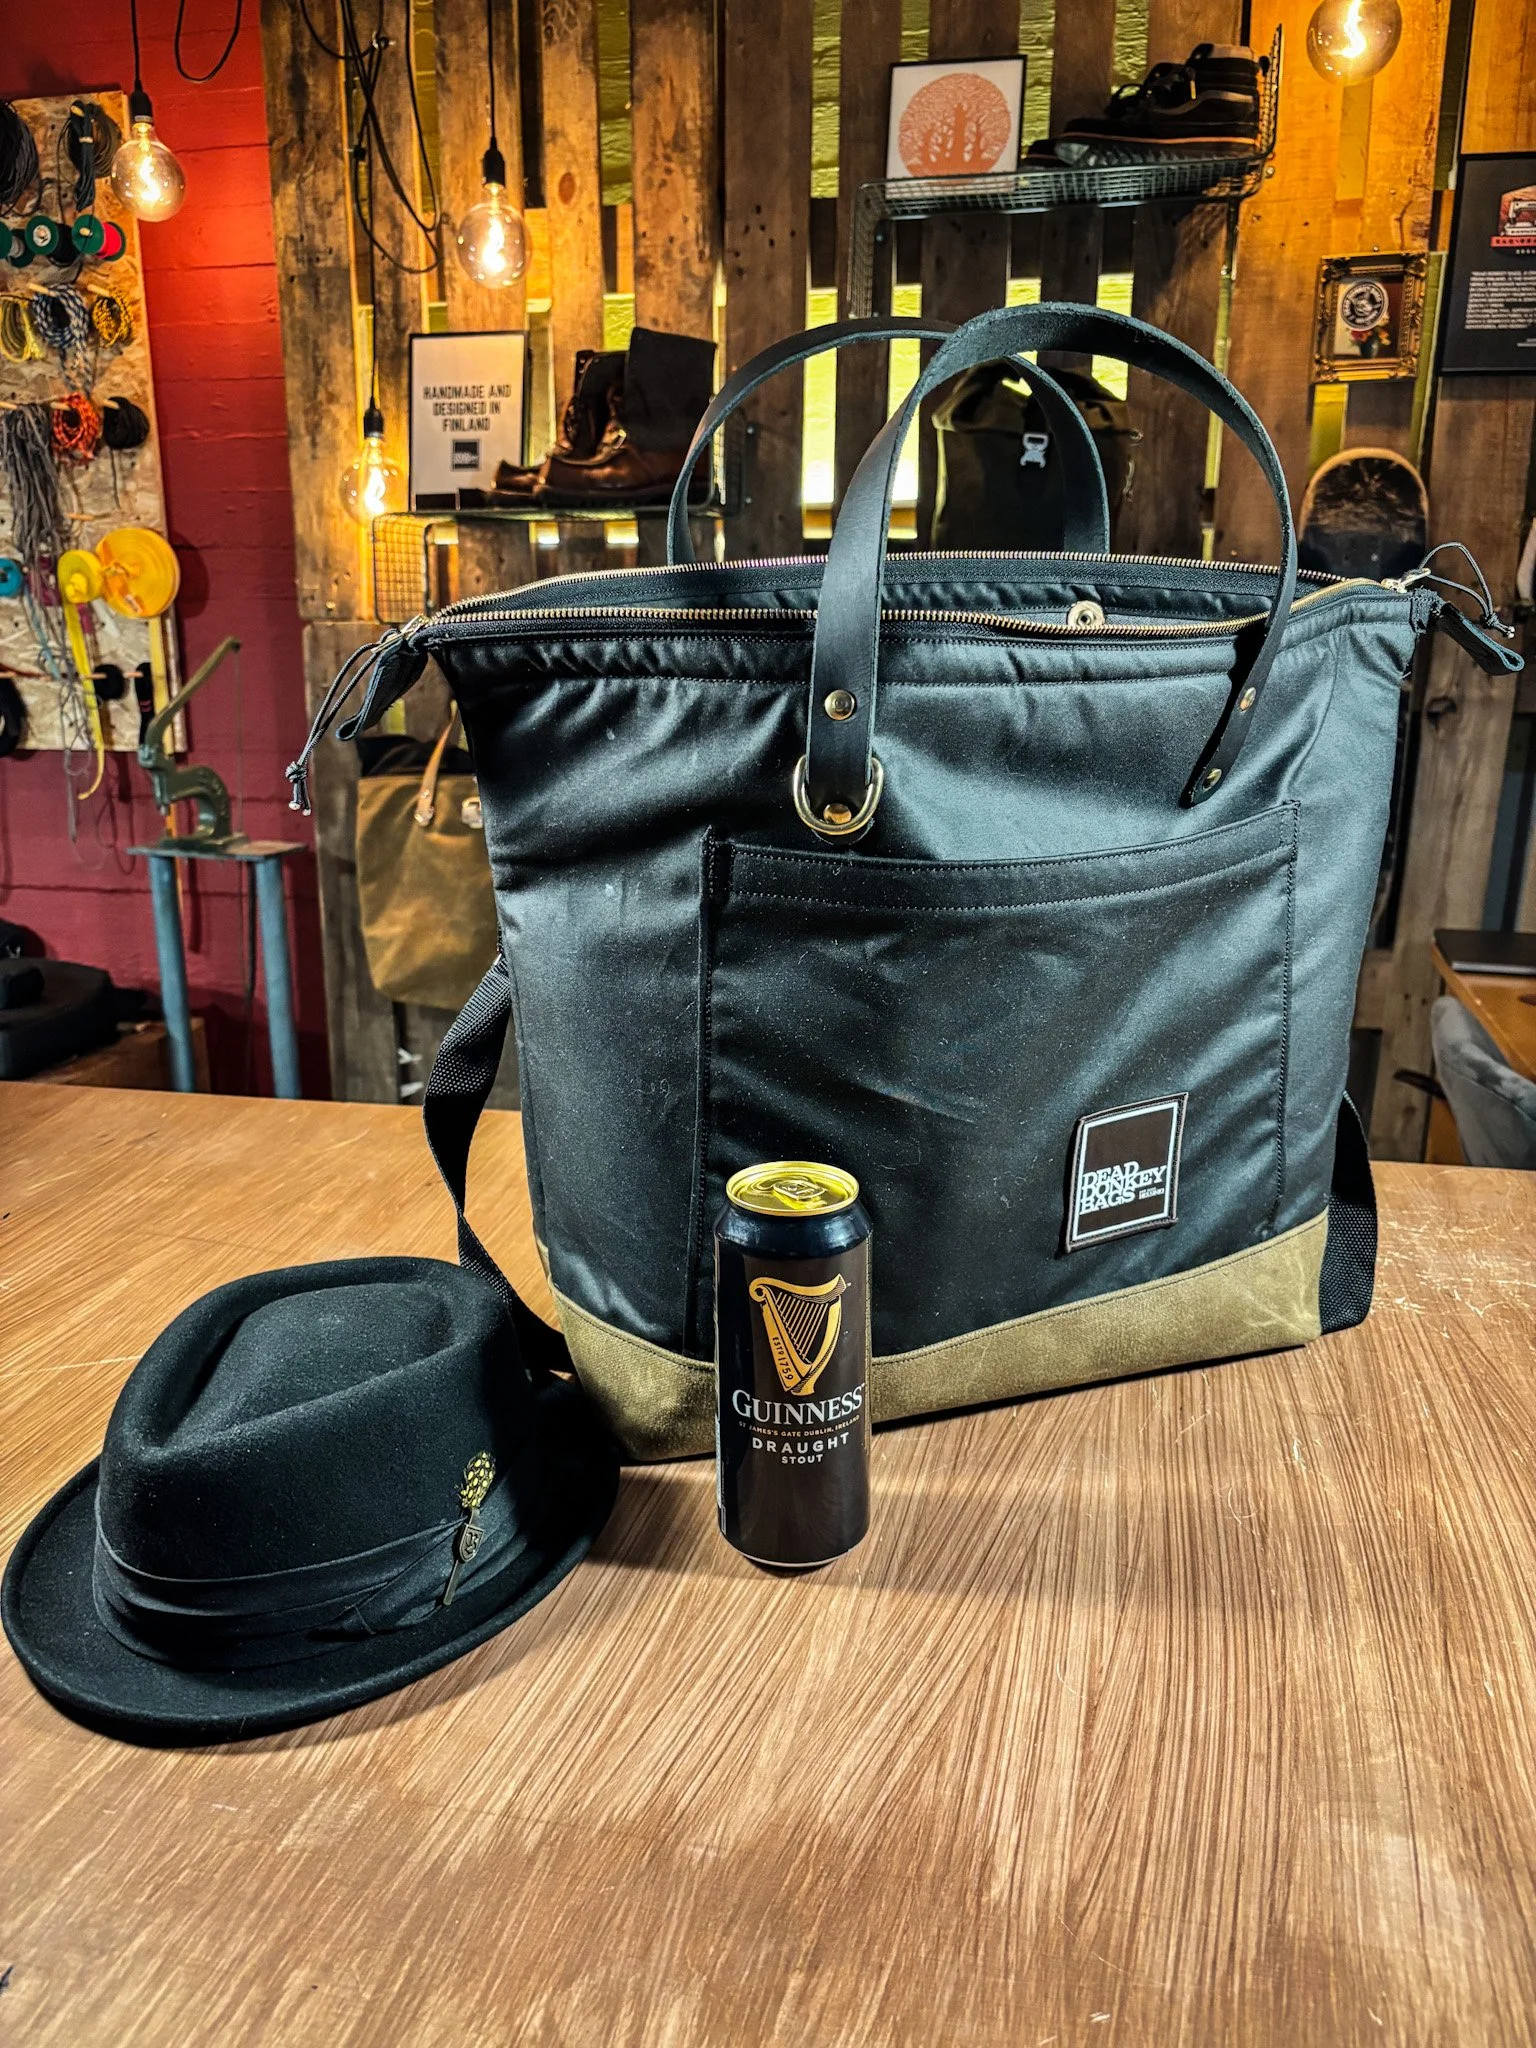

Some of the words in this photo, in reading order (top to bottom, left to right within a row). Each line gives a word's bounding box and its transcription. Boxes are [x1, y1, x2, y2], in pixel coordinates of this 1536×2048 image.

[423, 385, 485, 400] HANDMADE
[488, 384, 511, 399] AND
[433, 402, 486, 416] DESIGNED
[489, 402, 501, 415] IN
[443, 418, 490, 432] FINLAND
[1081, 1165, 1167, 1201] DONKEY
[1082, 1161, 1139, 1190] DEAD
[1079, 1187, 1136, 1215] BAGS
[778, 1357, 794, 1380] 1759
[732, 1386, 863, 1425] GUINNESS
[835, 1414, 860, 1430] IRELAND
[752, 1431, 850, 1453] DRAUGHT
[781, 1454, 824, 1465] STOUT
